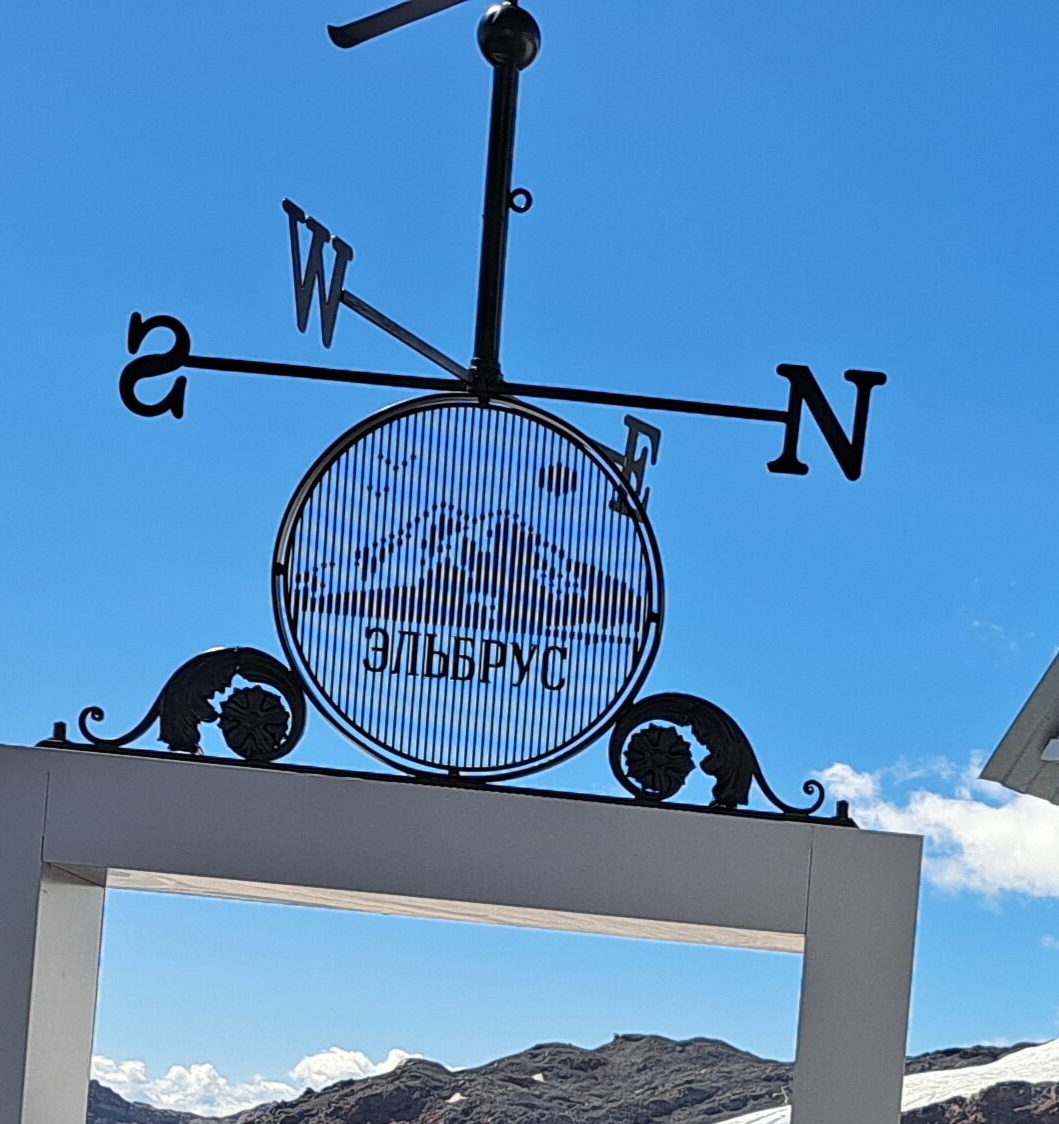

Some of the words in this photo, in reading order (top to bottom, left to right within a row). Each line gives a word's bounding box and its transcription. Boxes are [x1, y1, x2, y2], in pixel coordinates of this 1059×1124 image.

[282, 198, 353, 349] W
[608, 414, 662, 524] E
[767, 363, 887, 481] N
[362, 626, 568, 691] ЭЛЬБРУС
